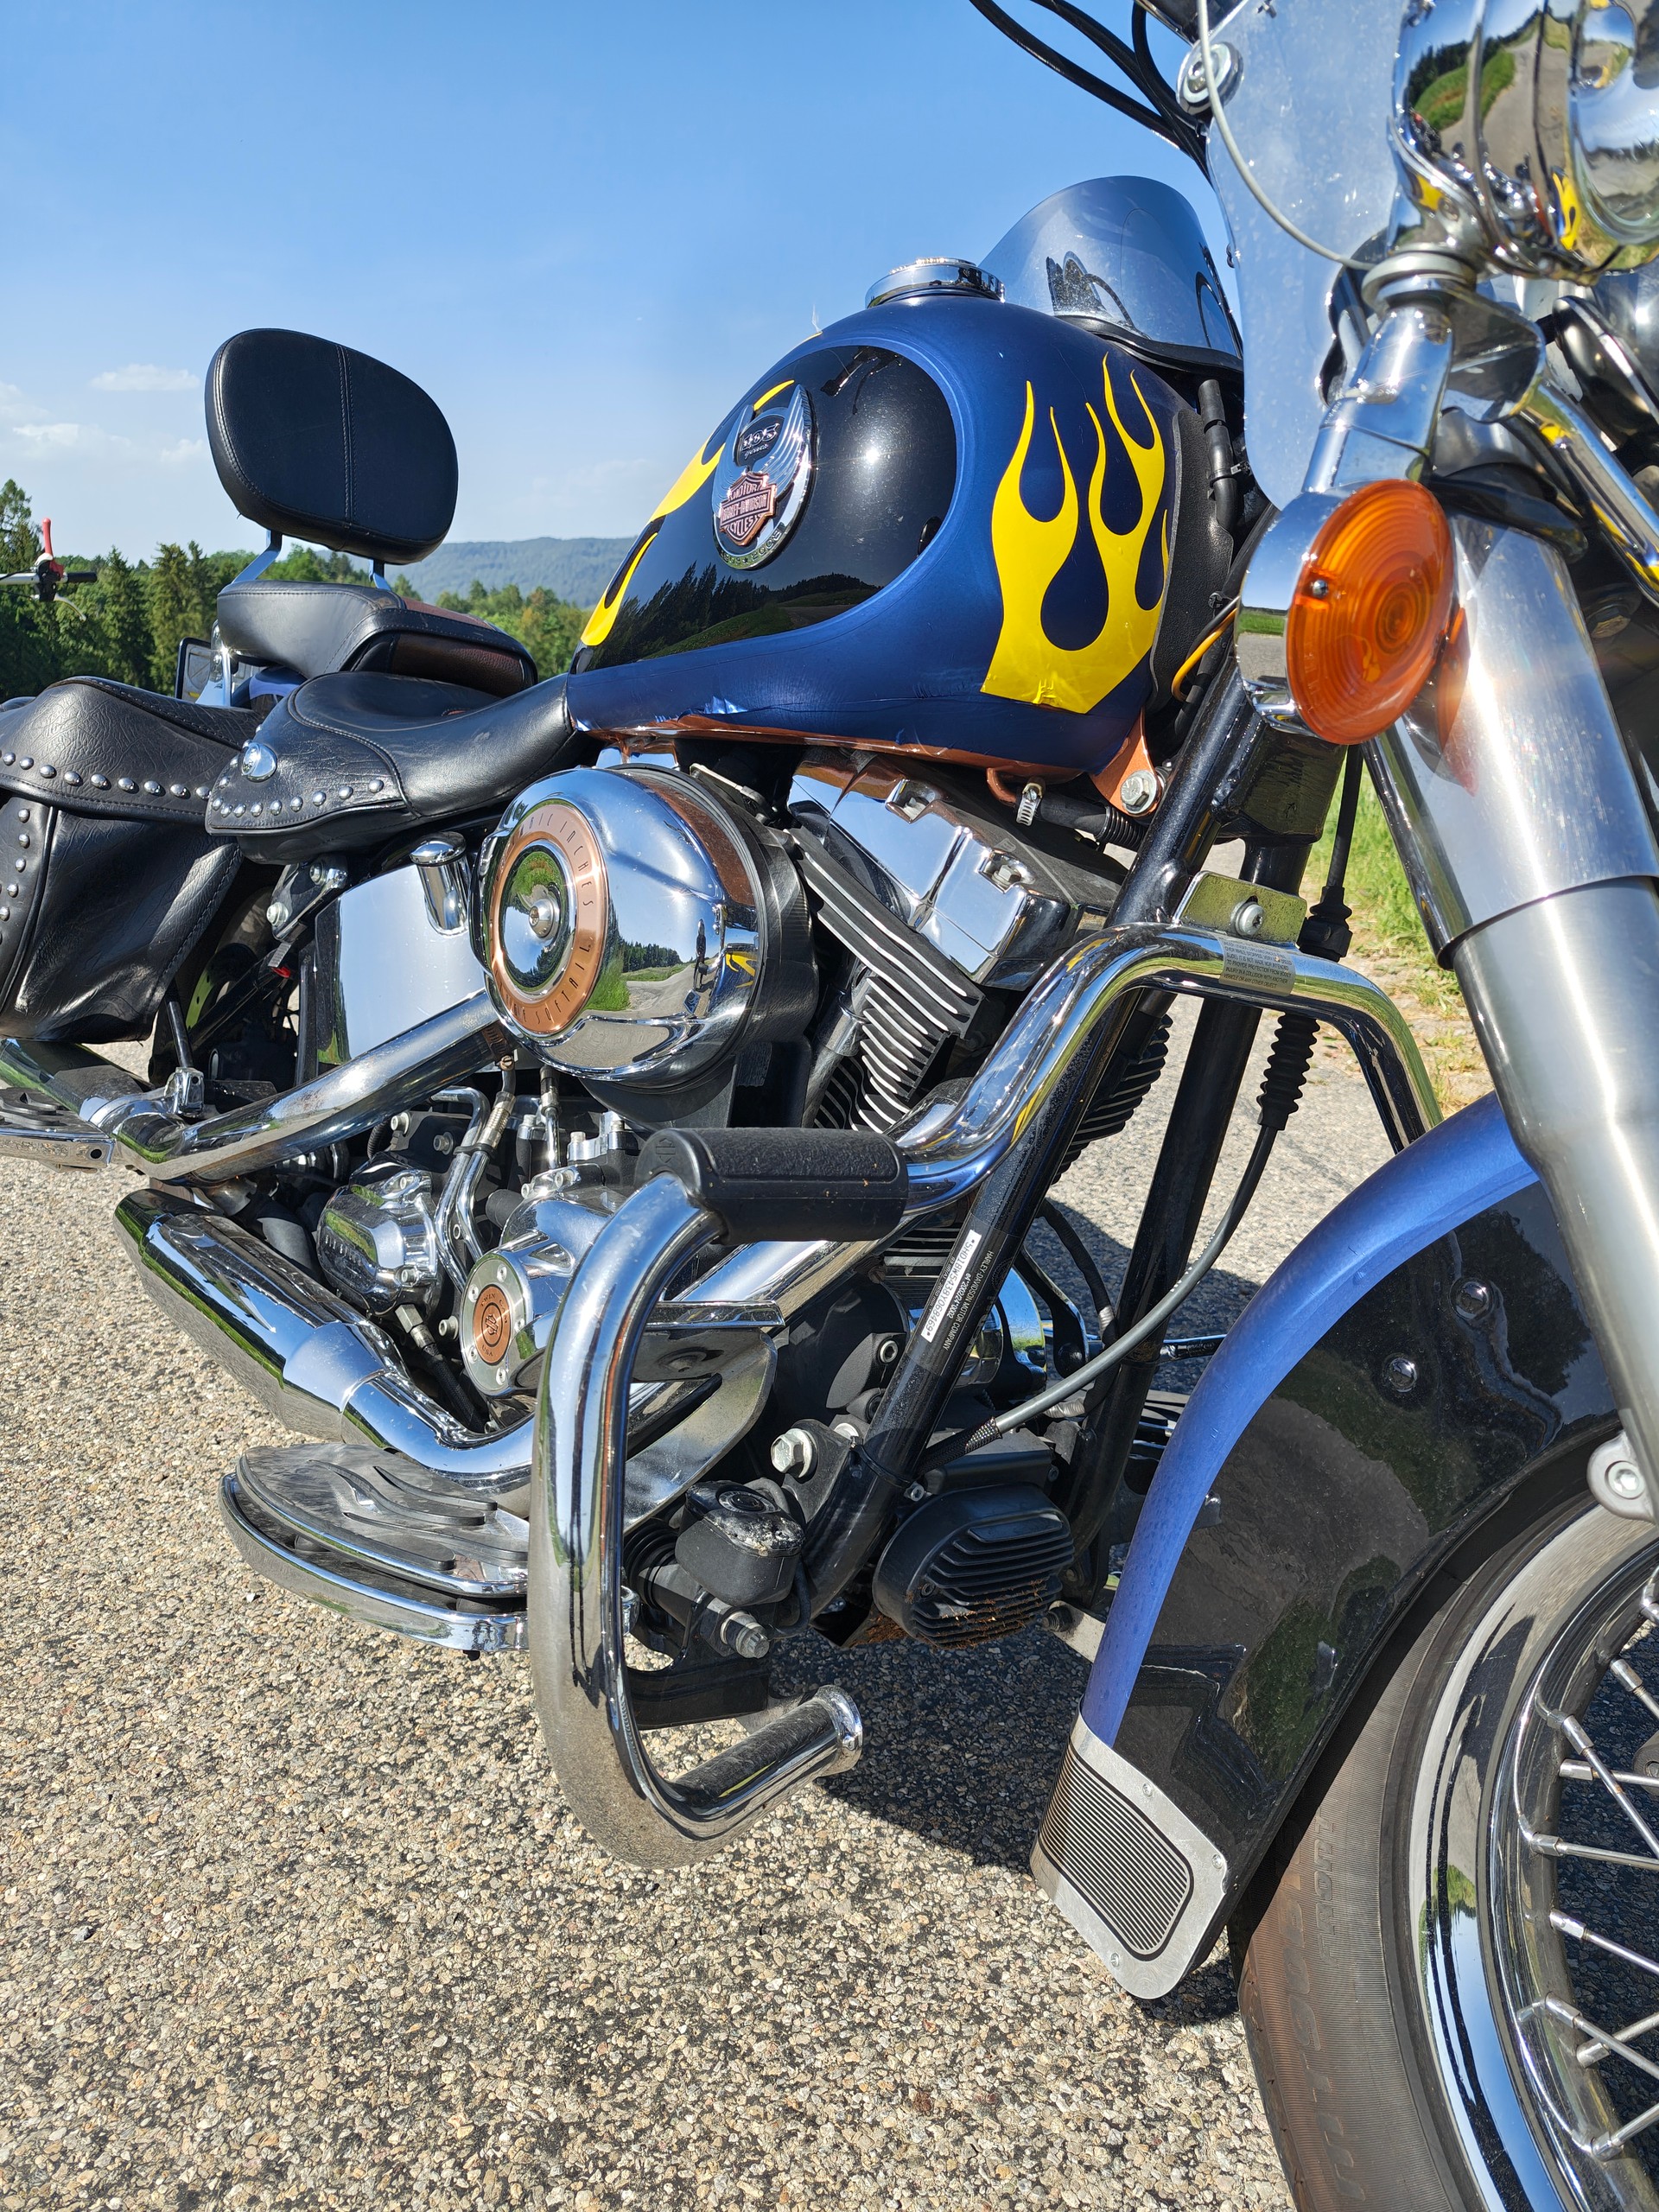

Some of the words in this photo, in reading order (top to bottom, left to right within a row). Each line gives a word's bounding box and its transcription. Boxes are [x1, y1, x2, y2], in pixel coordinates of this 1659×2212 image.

[741, 423, 779, 451] 105
[733, 481, 757, 499] MOTOR
[721, 493, 767, 522] HARLEY-DAVIDSON
[729, 516, 753, 536] CYCLES
[559, 821, 594, 906] INCHES
[965, 1250, 995, 1303] HARLEY-DAVIDSON
[956, 1301, 969, 1323] MOTOR
[481, 1344, 493, 1357] USA
[942, 1322, 960, 1351] COMPANY
[1313, 1807, 1339, 1967] FRONT
